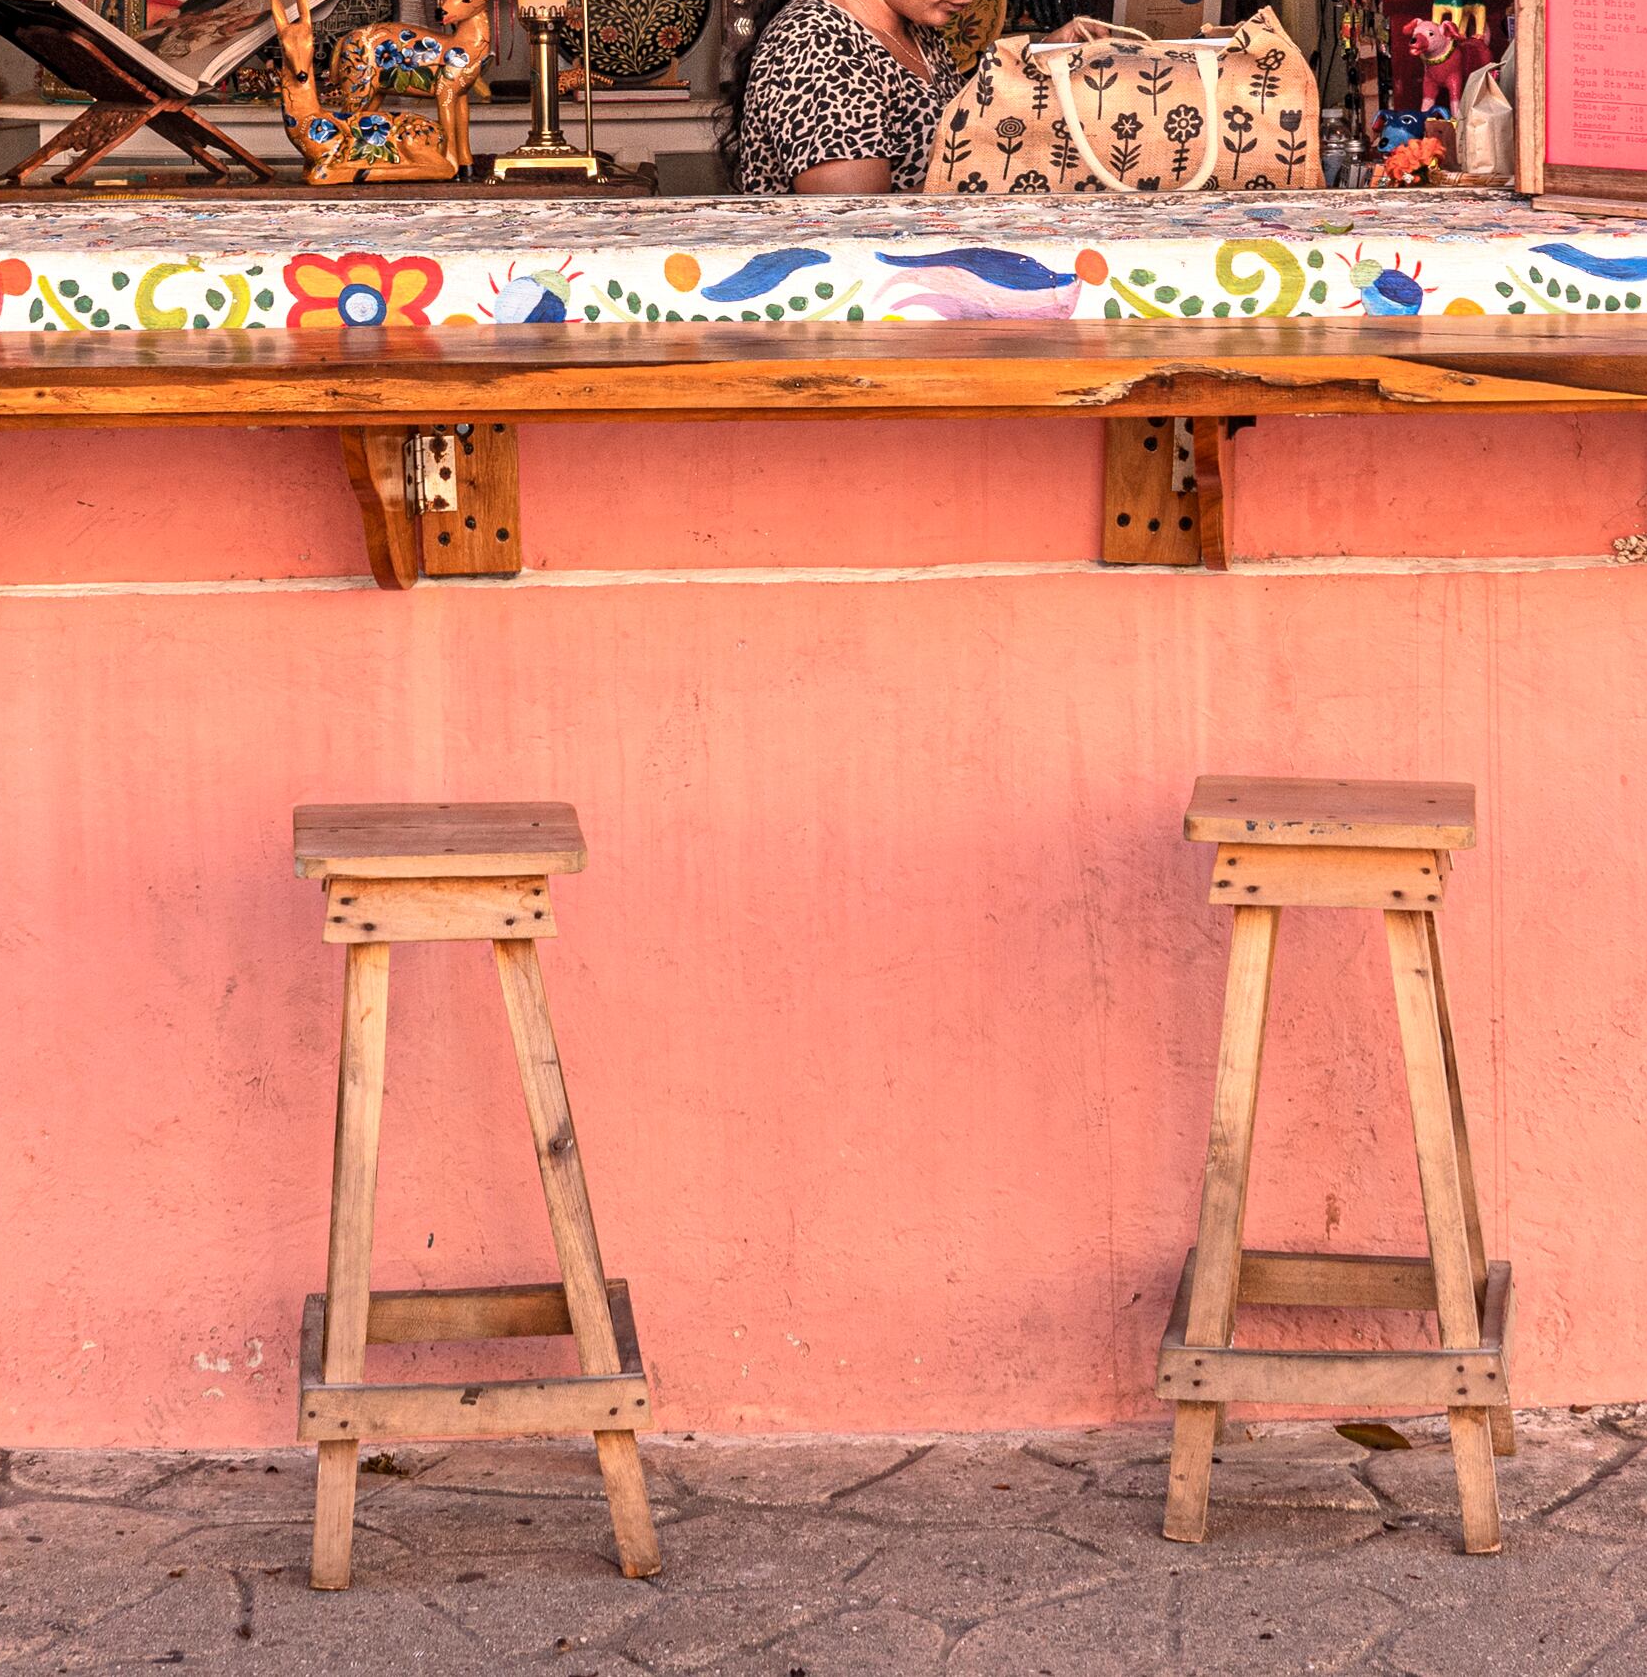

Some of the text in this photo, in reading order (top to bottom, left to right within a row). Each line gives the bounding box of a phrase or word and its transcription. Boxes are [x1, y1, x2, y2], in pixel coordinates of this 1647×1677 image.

[1604, 0, 1636, 9] White
[1572, 10, 1598, 19] Chai
[1604, 11, 1636, 21] Latte
[1572, 22, 1598, 31] Chai
[1604, 24, 1630, 33] Café
[1572, 42, 1604, 51] Mocca
[1573, 67, 1598, 76] Agua
[1603, 68, 1646, 78] Mineral
[1573, 79, 1598, 88] Agua
[1573, 91, 1622, 101] Kombucha
